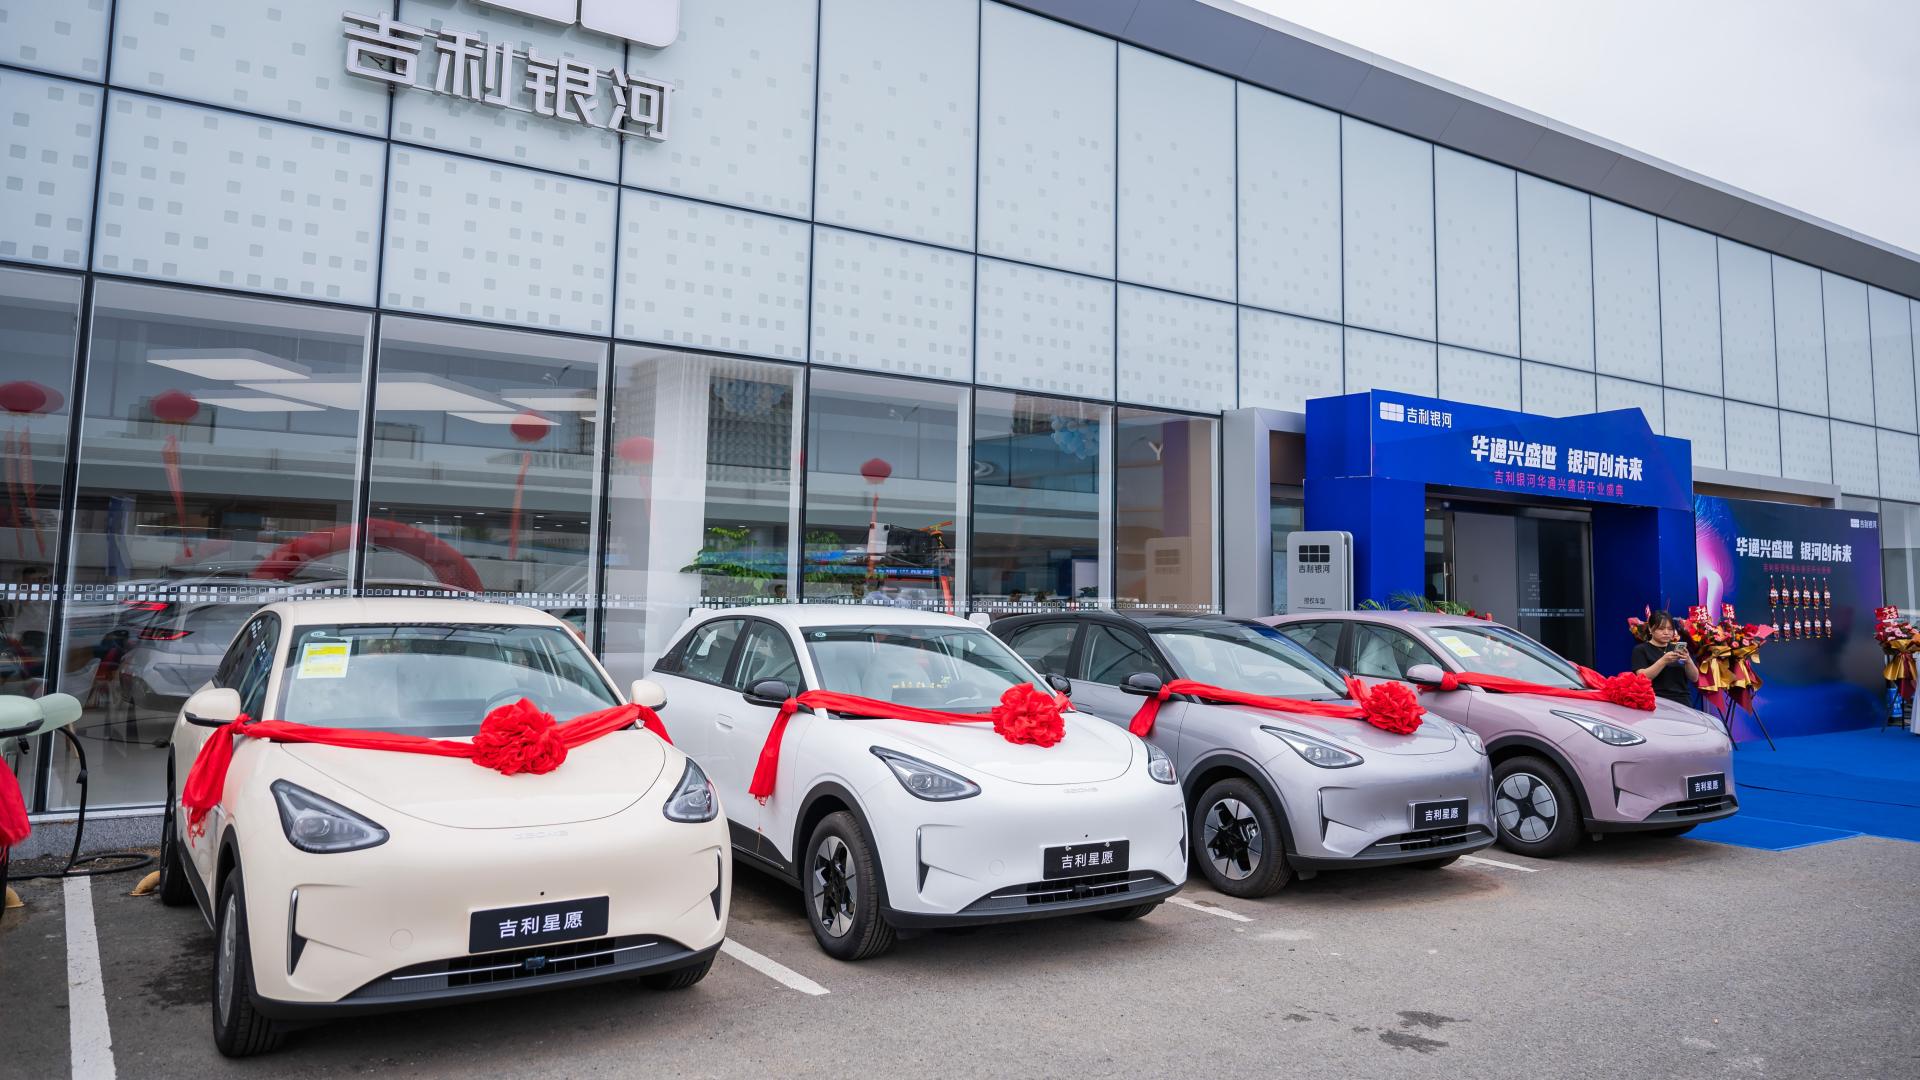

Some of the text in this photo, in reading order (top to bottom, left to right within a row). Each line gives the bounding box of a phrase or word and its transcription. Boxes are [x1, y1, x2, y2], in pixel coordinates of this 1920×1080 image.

[342, 9, 675, 142] 吉利银河
[1407, 407, 1452, 428] 吉利银河
[1471, 434, 1643, 481] 华通兴盛世 银河创未来
[1494, 469, 1625, 497] 吉利银河华通兴盛店开业盛典
[1736, 537, 1852, 563] 华通兴盛世 银河创未来
[1298, 564, 1331, 574] 吉利银河
[1694, 779, 1719, 793] 吉利星愿
[1425, 807, 1459, 822] 吉利星愿
[1061, 850, 1114, 869] 吉利星愿
[499, 910, 583, 939] 吉利星愿
